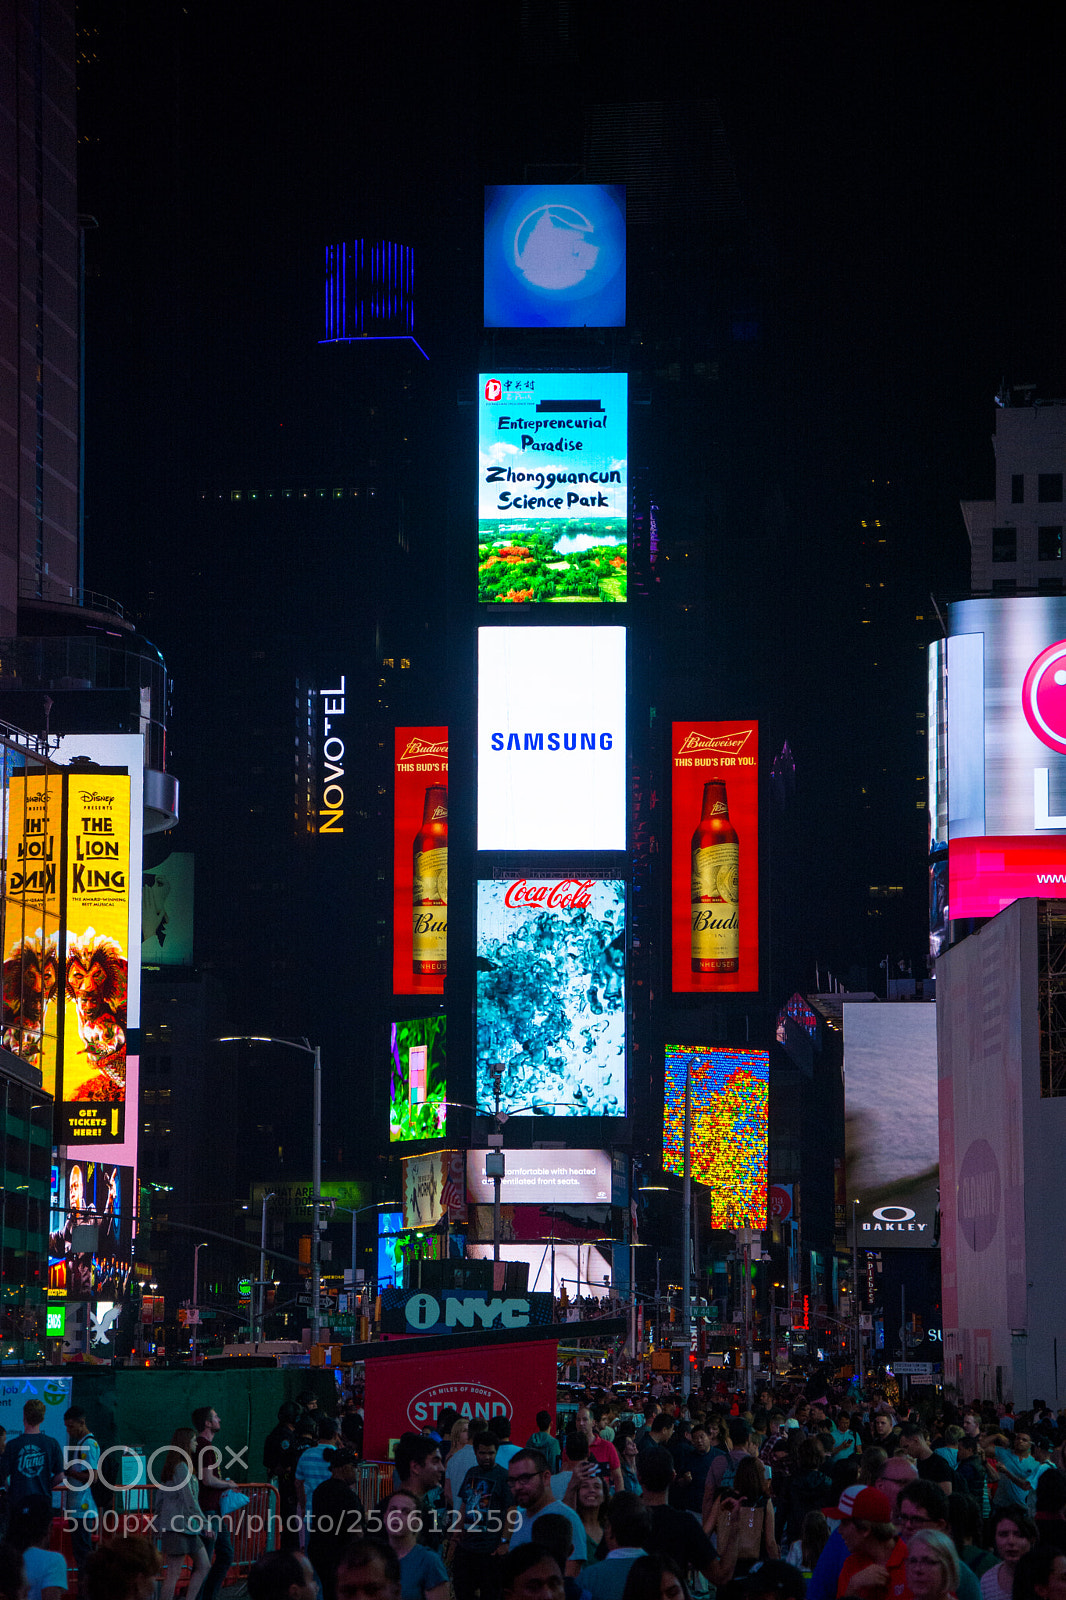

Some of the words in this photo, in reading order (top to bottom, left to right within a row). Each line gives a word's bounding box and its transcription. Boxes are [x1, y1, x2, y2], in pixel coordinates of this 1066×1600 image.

[498, 415, 607, 433] Entrepreneurial
[521, 434, 583, 452] Paradise
[485, 466, 622, 490] Zhongguancun
[497, 491, 564, 510] Science
[566, 491, 609, 509] Park
[491, 732, 613, 751] SAMSUNG
[684, 736, 745, 749] Budweiser
[319, 675, 345, 833] NOVOTEL
[675, 758, 693, 767] THIS
[694, 758, 719, 767] BUD'S
[720, 757, 736, 766] FOR
[738, 756, 757, 766] YOU.
[397, 763, 415, 772] THIS
[416, 763, 440, 772] BUD'S
[81, 817, 113, 832] THE
[76, 835, 119, 861] LION
[72, 863, 125, 894] KING
[505, 879, 596, 909] Coca-Cola
[79, 1109, 98, 1117] GET
[69, 1118, 107, 1126] TICKETS
[73, 1128, 102, 1136] HERE!
[551, 1167, 567, 1175] with
[569, 1167, 596, 1175] heated
[863, 1223, 926, 1231] OAKLEY
[445, 1297, 530, 1328] NYC
[438, 1387, 458, 1395] MILES
